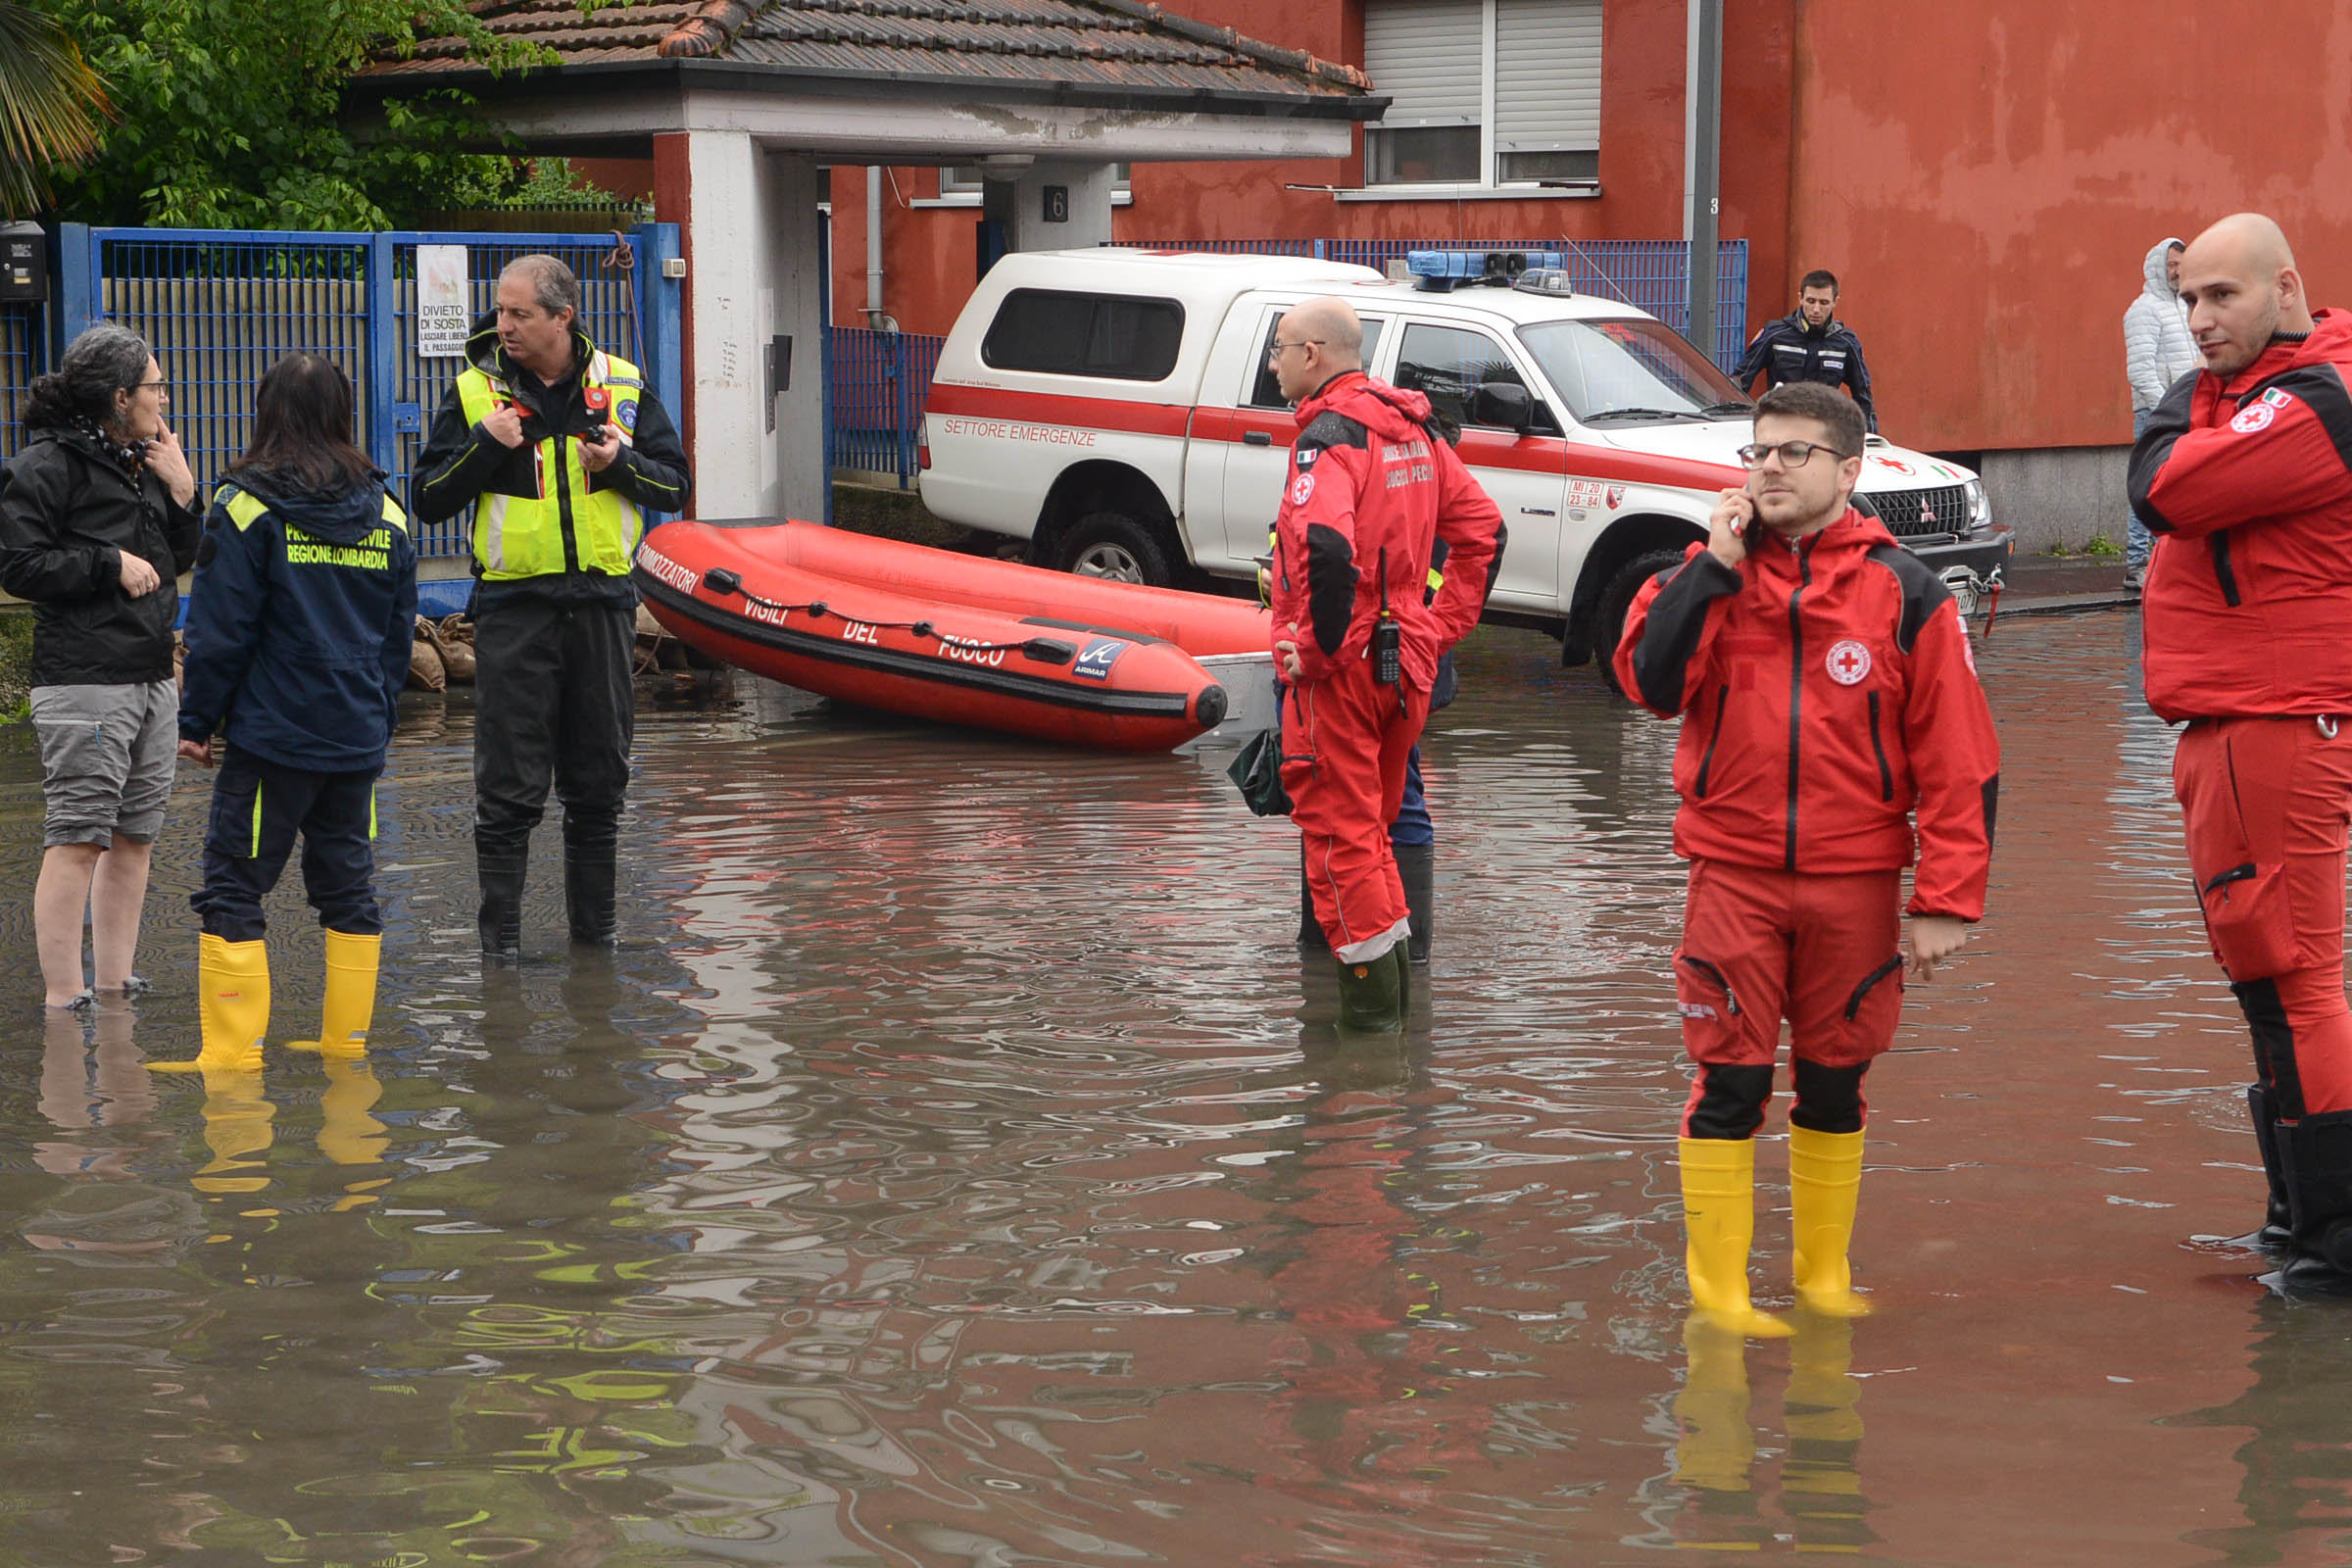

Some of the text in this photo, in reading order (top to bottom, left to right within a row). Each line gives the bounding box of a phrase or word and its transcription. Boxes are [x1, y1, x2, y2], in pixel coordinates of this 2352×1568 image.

[1054, 192, 1063, 217] 6
[1710, 197, 1718, 215] 3
[422, 305, 464, 316] DIVIETO
[420, 318, 466, 329] DI SOSTA
[944, 419, 1097, 447] SETTORE EMERGENZE
[1589, 483, 1600, 493] 20
[287, 544, 389, 570] REGIONE LOMBARDIA
[745, 595, 1005, 666] VIGILI DEL FUOCO
[1074, 665, 1106, 677] ARIMAR
